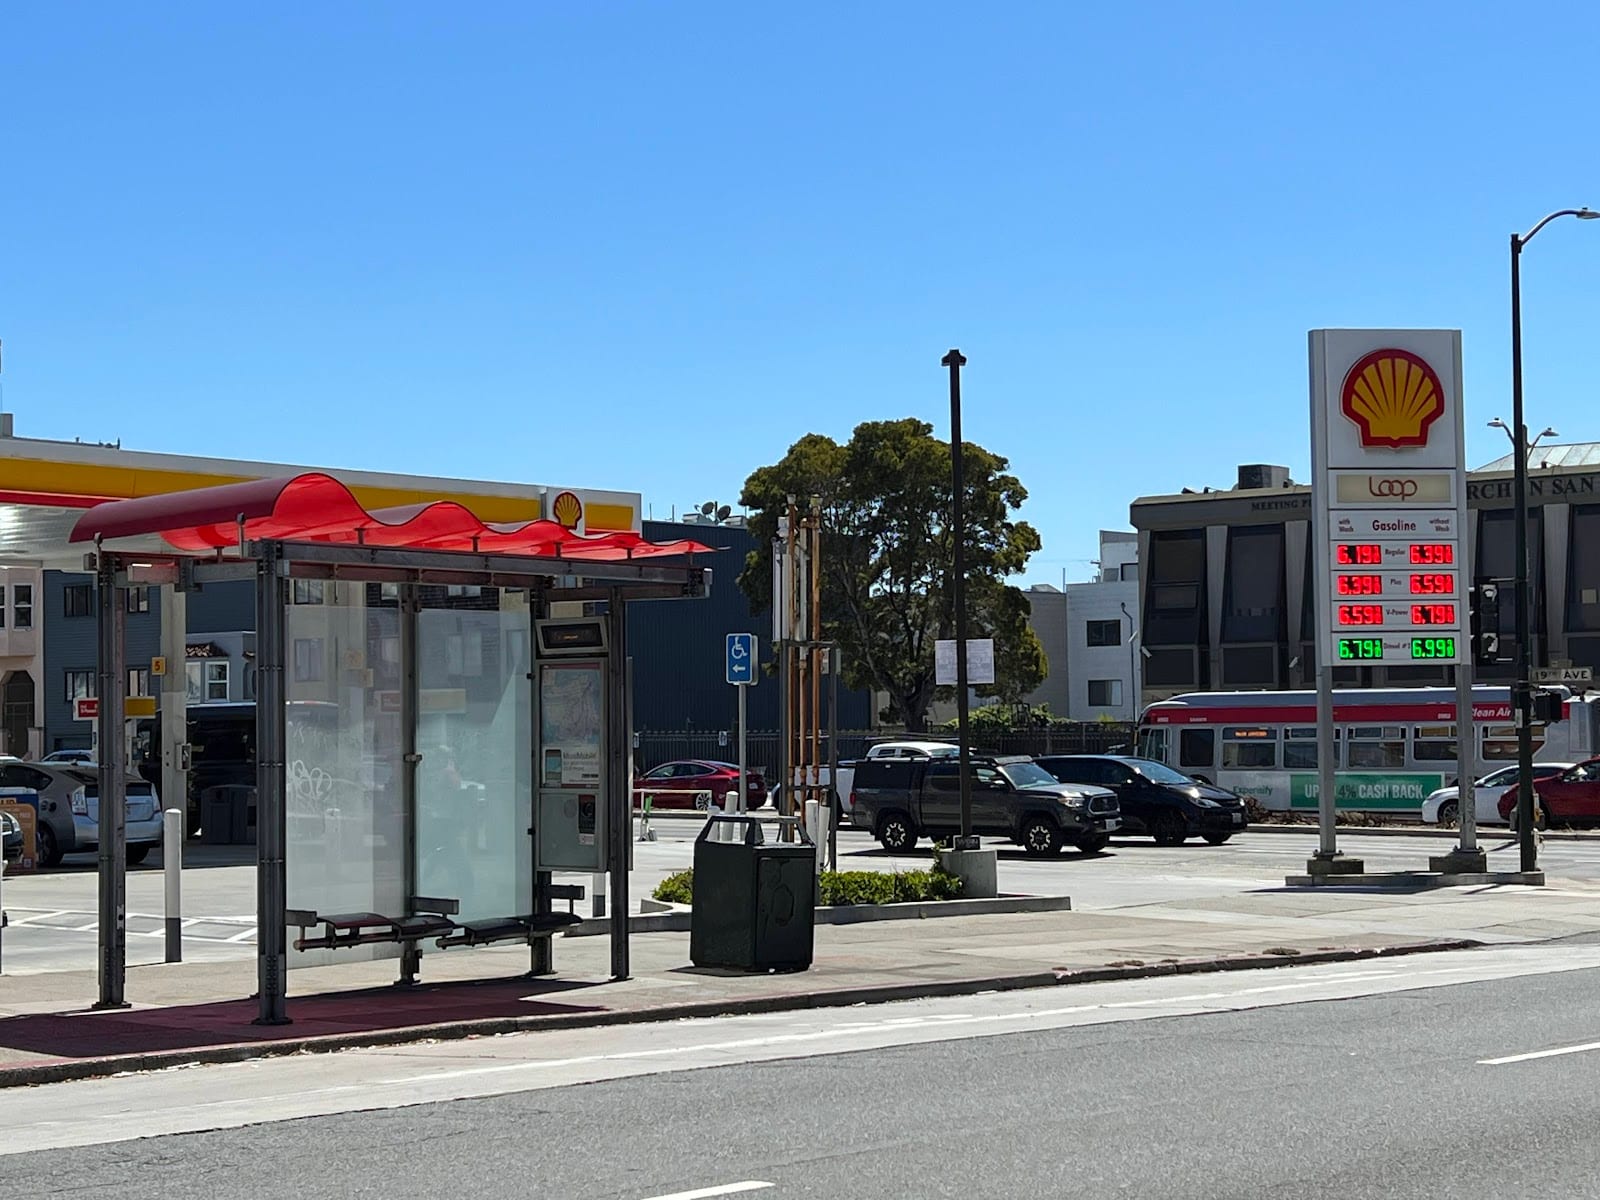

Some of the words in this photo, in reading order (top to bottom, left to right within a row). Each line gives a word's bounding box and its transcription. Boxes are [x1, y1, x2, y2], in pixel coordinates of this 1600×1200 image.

[1467, 482, 1511, 500] RCH
[1552, 477, 1594, 494] SAN
[1251, 500, 1298, 511] MEETING
[1372, 519, 1417, 531] Gasoline
[1385, 608, 1409, 616] V-Power
[155, 661, 161, 672] 5
[1563, 670, 1589, 679] AVE
[1496, 707, 1511, 717] Air
[1359, 784, 1389, 799] CASH
